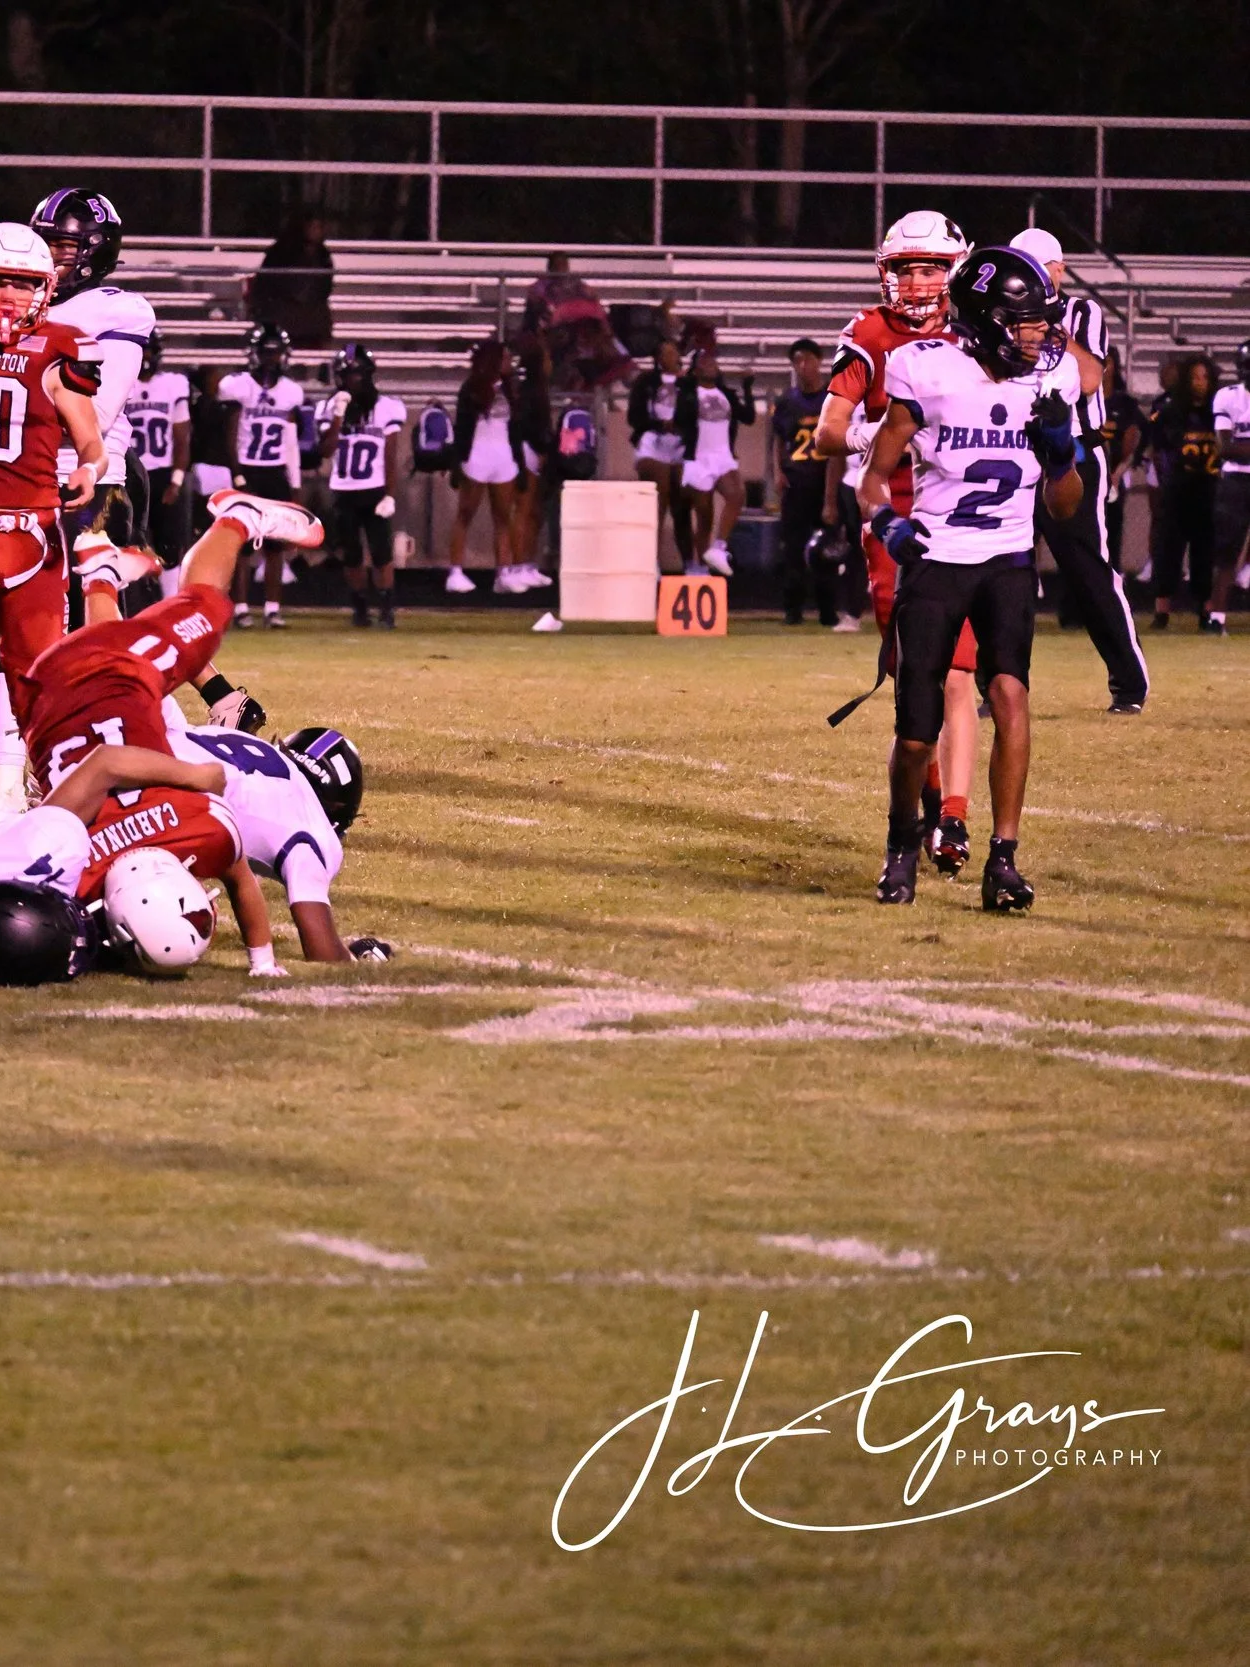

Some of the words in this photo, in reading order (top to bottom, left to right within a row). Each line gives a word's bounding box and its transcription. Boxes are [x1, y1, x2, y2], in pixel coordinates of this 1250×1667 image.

[972, 263, 997, 293] 2
[246, 422, 284, 461] 12
[791, 428, 830, 461] 2
[934, 424, 1034, 453] PHARAO
[336, 438, 379, 480] 10
[945, 458, 1023, 530] 2
[671, 584, 717, 630] 40
[172, 611, 213, 644] CARDS
[83, 801, 180, 868] CARDINAL
